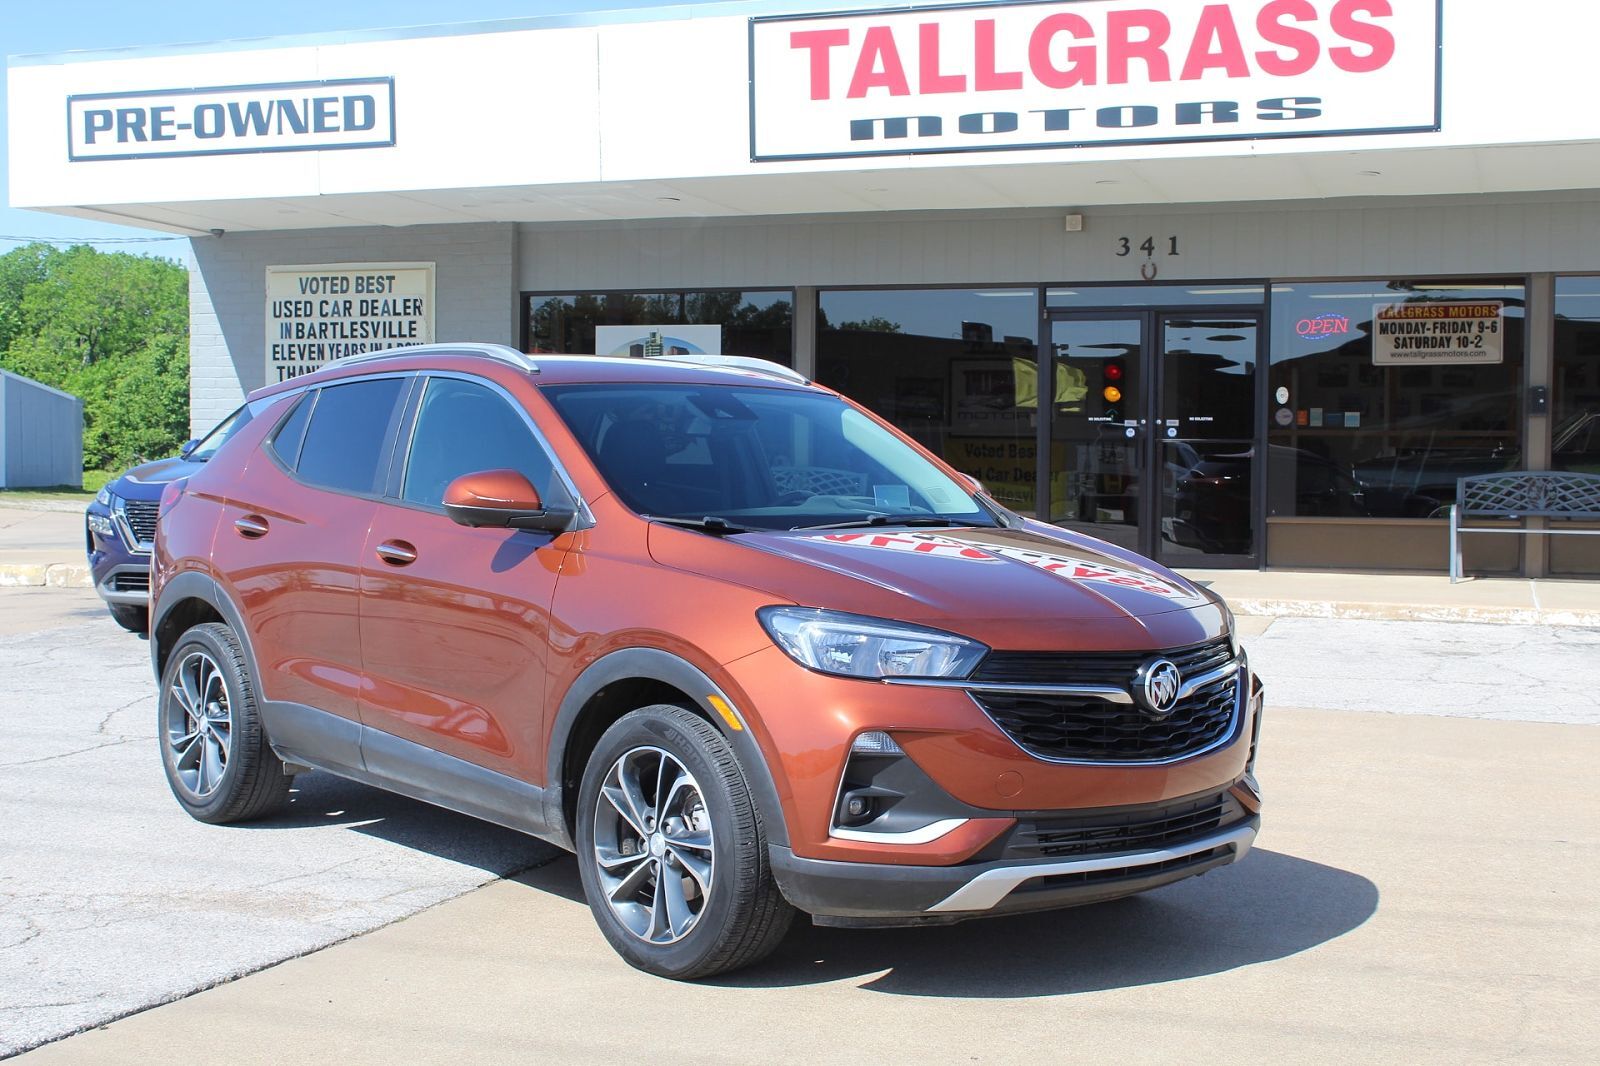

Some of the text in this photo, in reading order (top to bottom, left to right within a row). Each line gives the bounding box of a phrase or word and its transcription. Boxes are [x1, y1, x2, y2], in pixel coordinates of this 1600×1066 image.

[790, 0, 1395, 101] TALLGRASS
[83, 95, 376, 144] PRE-OWNED
[850, 96, 1322, 141] MOTORS
[1115, 235, 1180, 258] 341
[299, 275, 396, 295] VOTED BEST
[272, 298, 423, 318] USED CAR DEALER
[1449, 306, 1497, 317] MOTORS
[280, 320, 418, 339] IN BARTLESVILLE
[1296, 317, 1350, 335] OPEN
[1477, 321, 1498, 334] 9-6
[272, 343, 325, 361] ELEVEN
[328, 342, 367, 360] YEARS
[1393, 335, 1483, 349] SATURDAY 10-2
[1390, 350, 1487, 359] www.tallgrassmotors.com
[964, 443, 1005, 458] Voted
[986, 467, 1010, 481] Car
